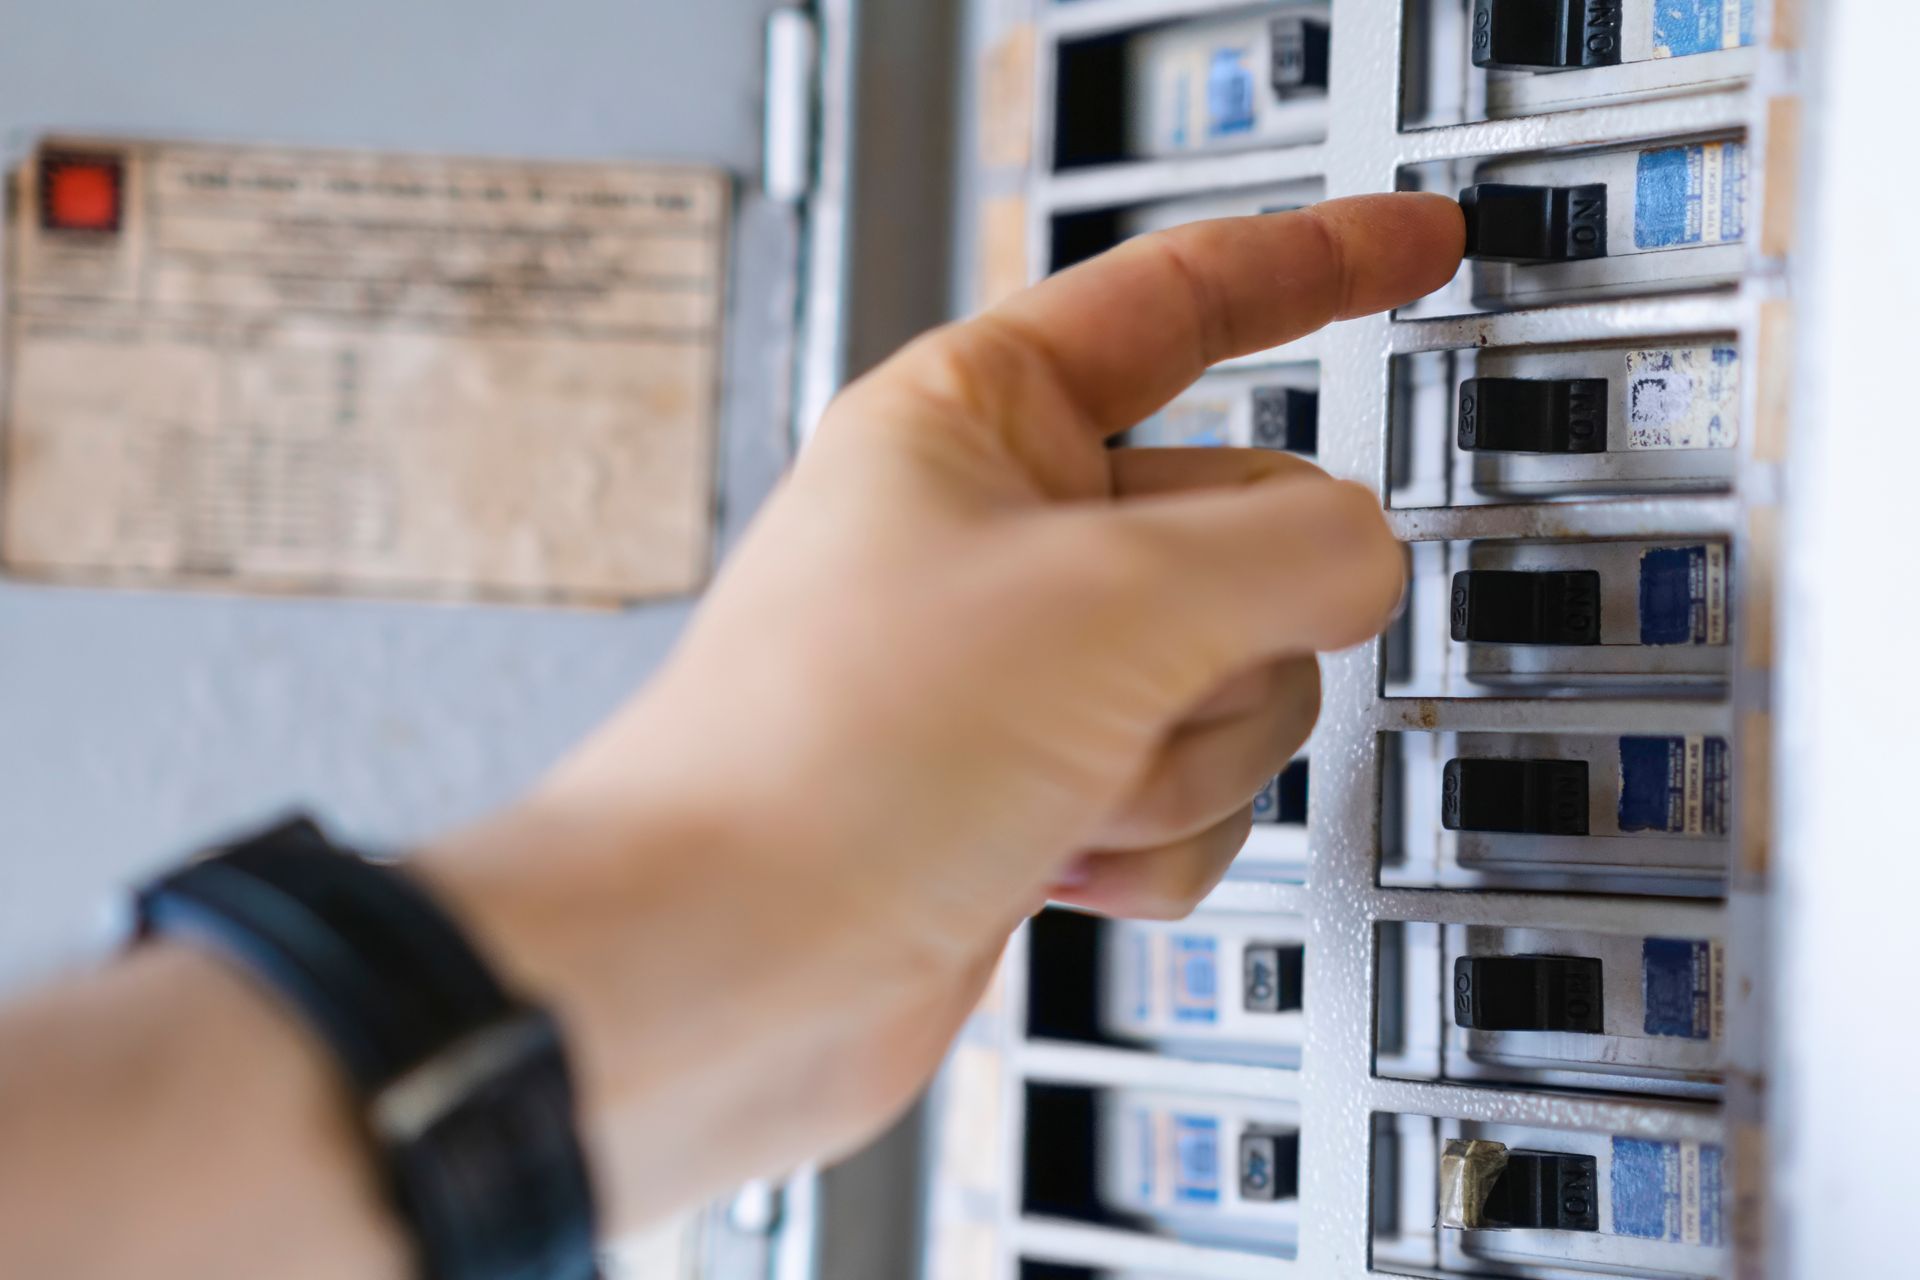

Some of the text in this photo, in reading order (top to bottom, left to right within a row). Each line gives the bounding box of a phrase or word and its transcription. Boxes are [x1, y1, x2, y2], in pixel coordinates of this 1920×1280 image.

[1586, 7, 1615, 52] ON
[1572, 199, 1599, 244] ON
[1707, 210, 1716, 237] TYPE
[1460, 396, 1474, 434] 20
[1570, 393, 1594, 438] ON
[1452, 587, 1466, 626] 20
[1566, 588, 1591, 631] ON
[1557, 776, 1579, 821] ON
[1455, 972, 1470, 1014] 20
[1567, 973, 1592, 1018] ON
[1563, 1170, 1590, 1214] ON
